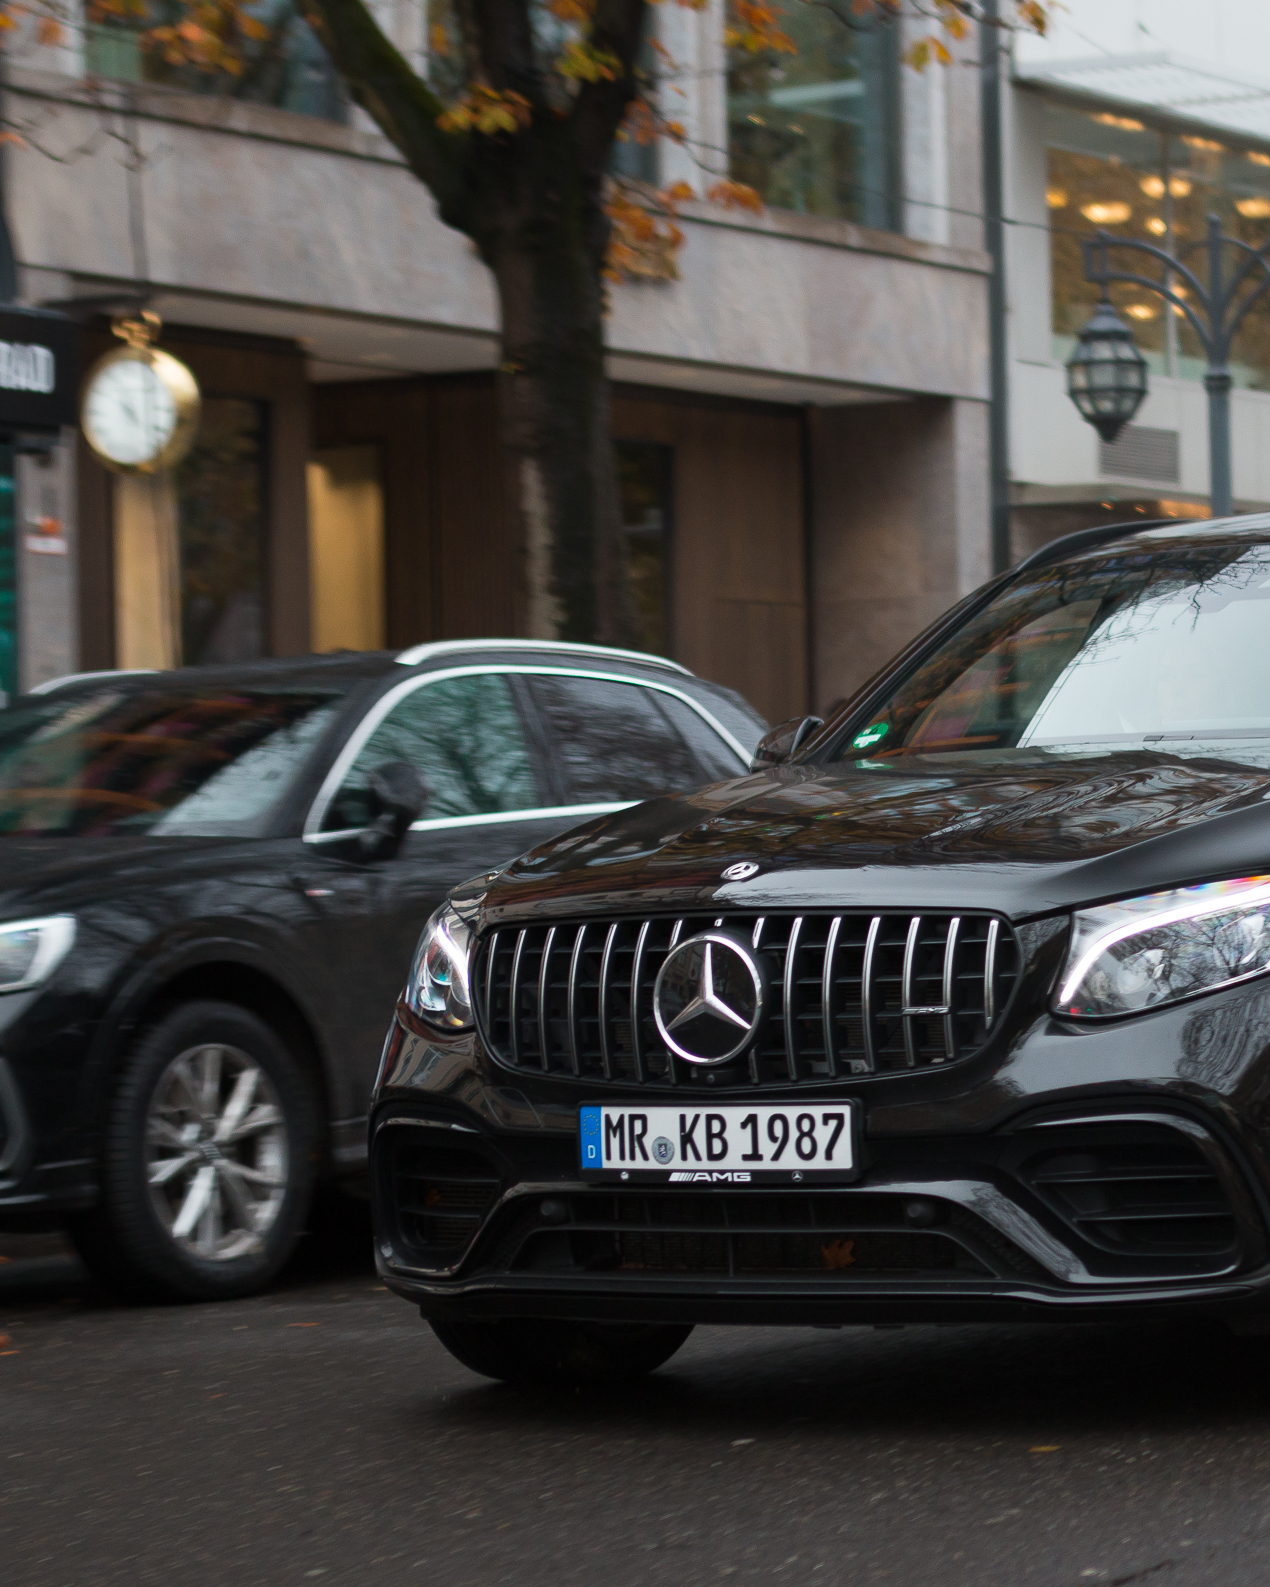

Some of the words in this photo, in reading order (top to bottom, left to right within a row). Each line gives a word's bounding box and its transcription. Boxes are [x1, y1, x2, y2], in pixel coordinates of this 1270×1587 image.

[604, 1112, 650, 1162] MR
[679, 1112, 729, 1162] KB
[740, 1112, 845, 1162] 1987
[587, 1144, 596, 1159] D
[692, 1171, 752, 1182] AMG
